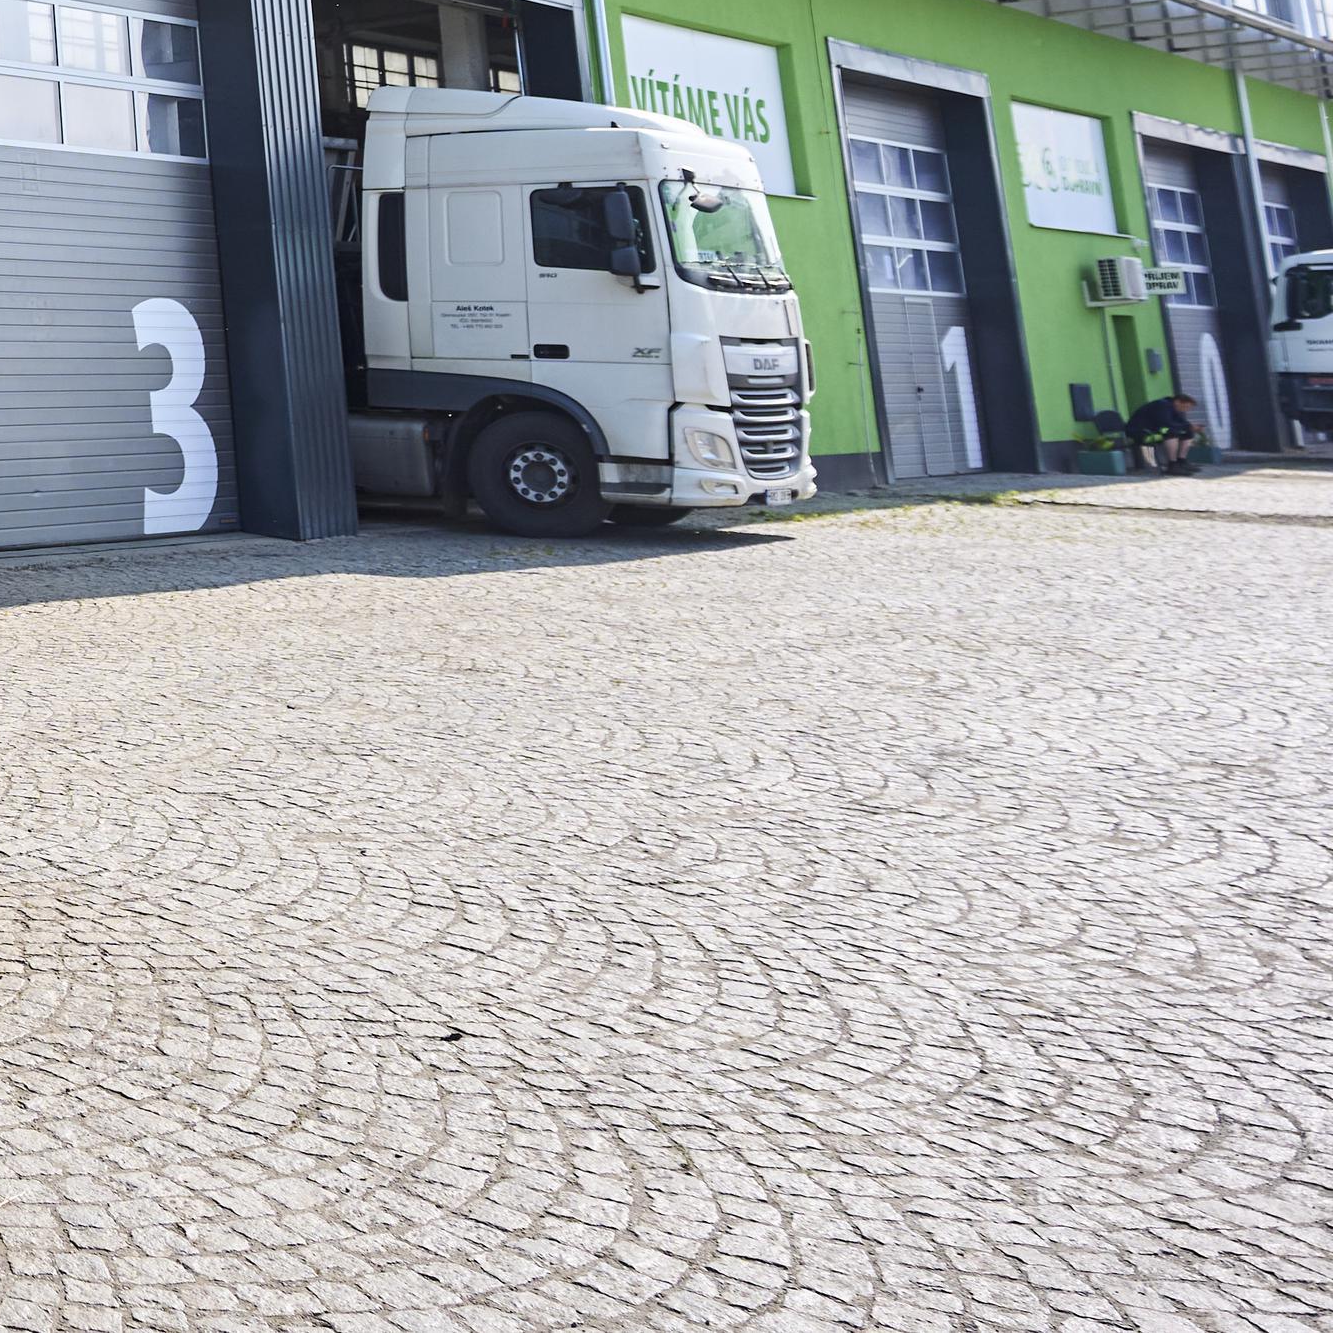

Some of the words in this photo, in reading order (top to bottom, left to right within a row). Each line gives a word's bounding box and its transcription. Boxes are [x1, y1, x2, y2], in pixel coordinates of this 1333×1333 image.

[630, 69, 723, 137] VÍTÁME
[724, 87, 771, 144] VÁS
[131, 298, 219, 534] 3
[753, 358, 779, 370] DAF
[941, 326, 983, 468] 1
[1199, 332, 1231, 449] 0
